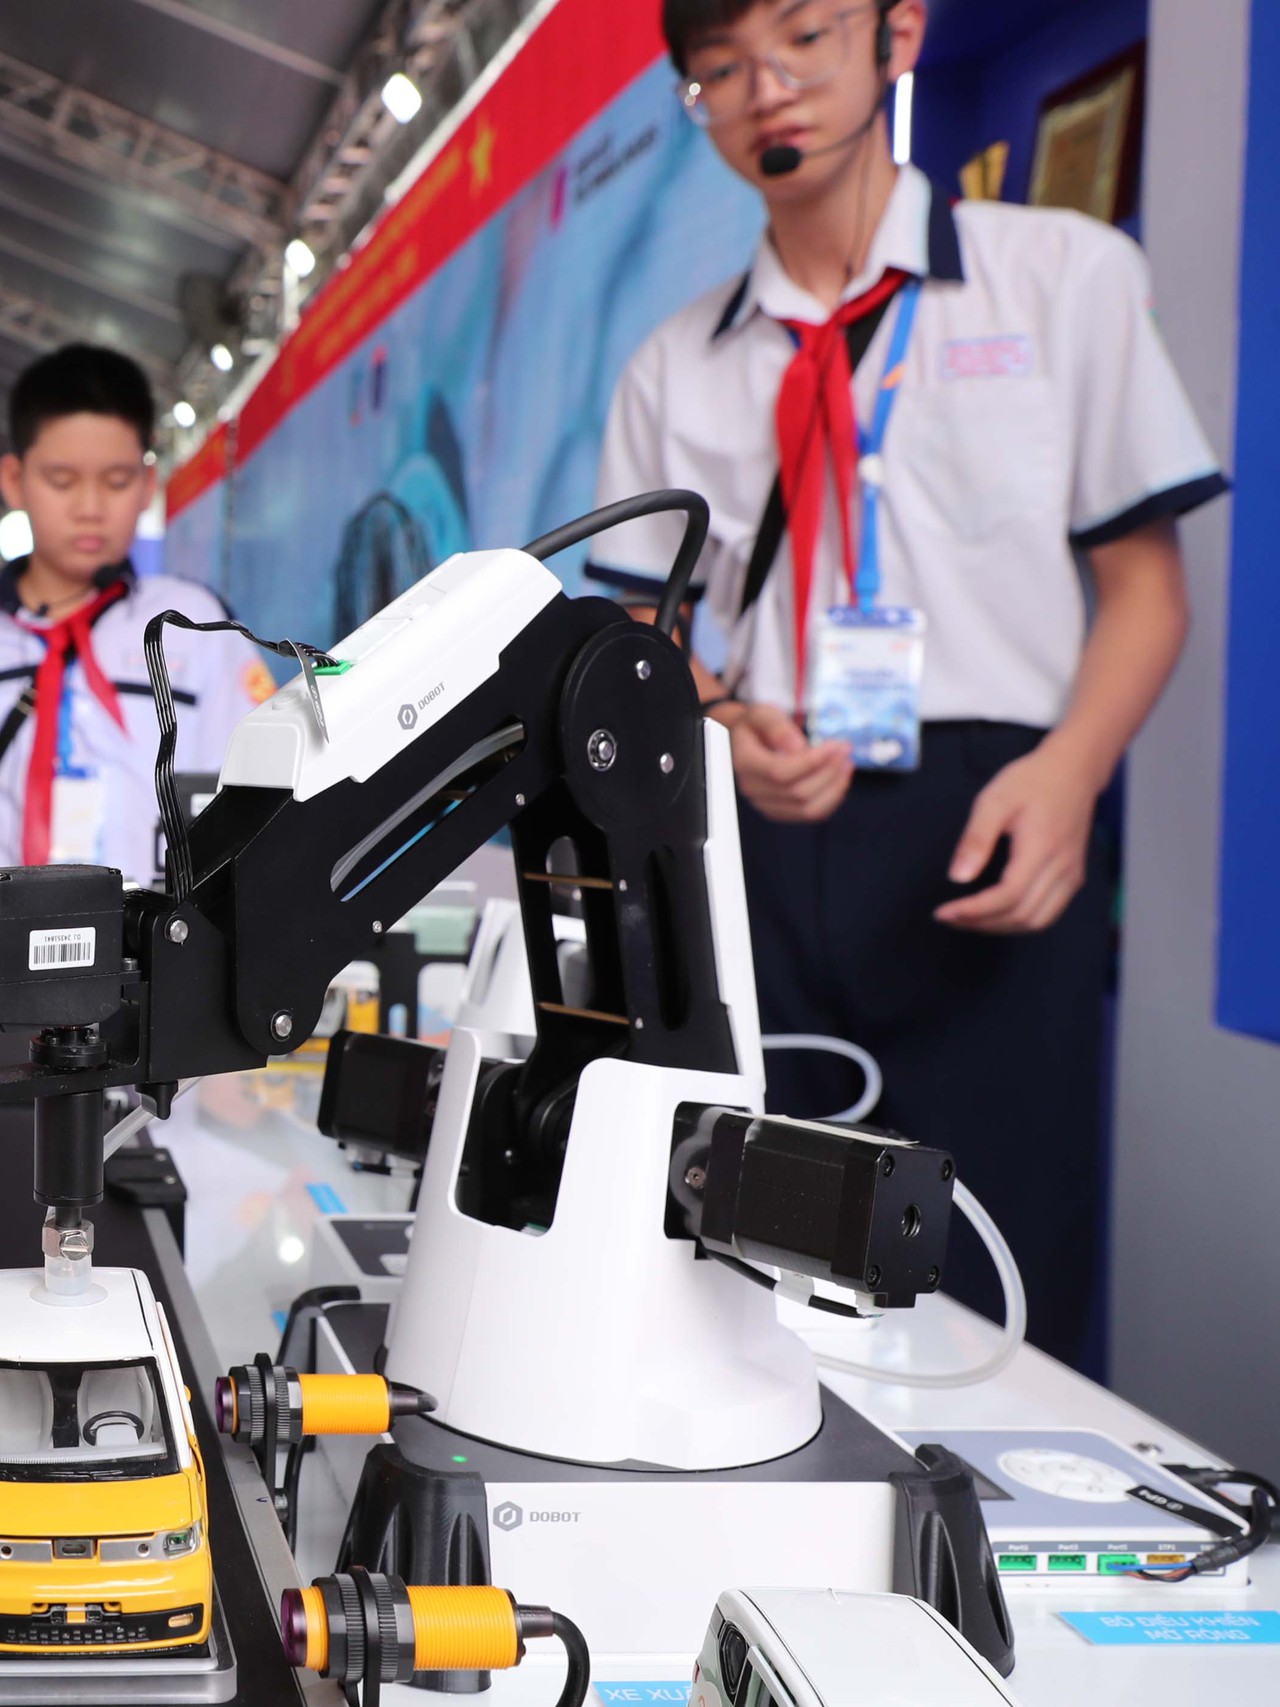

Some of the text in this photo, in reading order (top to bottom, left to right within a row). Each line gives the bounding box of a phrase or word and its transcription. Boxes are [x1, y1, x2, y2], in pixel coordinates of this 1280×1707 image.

[418, 681, 445, 710] DOBOT
[529, 1511, 582, 1523] DOBOT
[604, 1688, 643, 1701] XE
